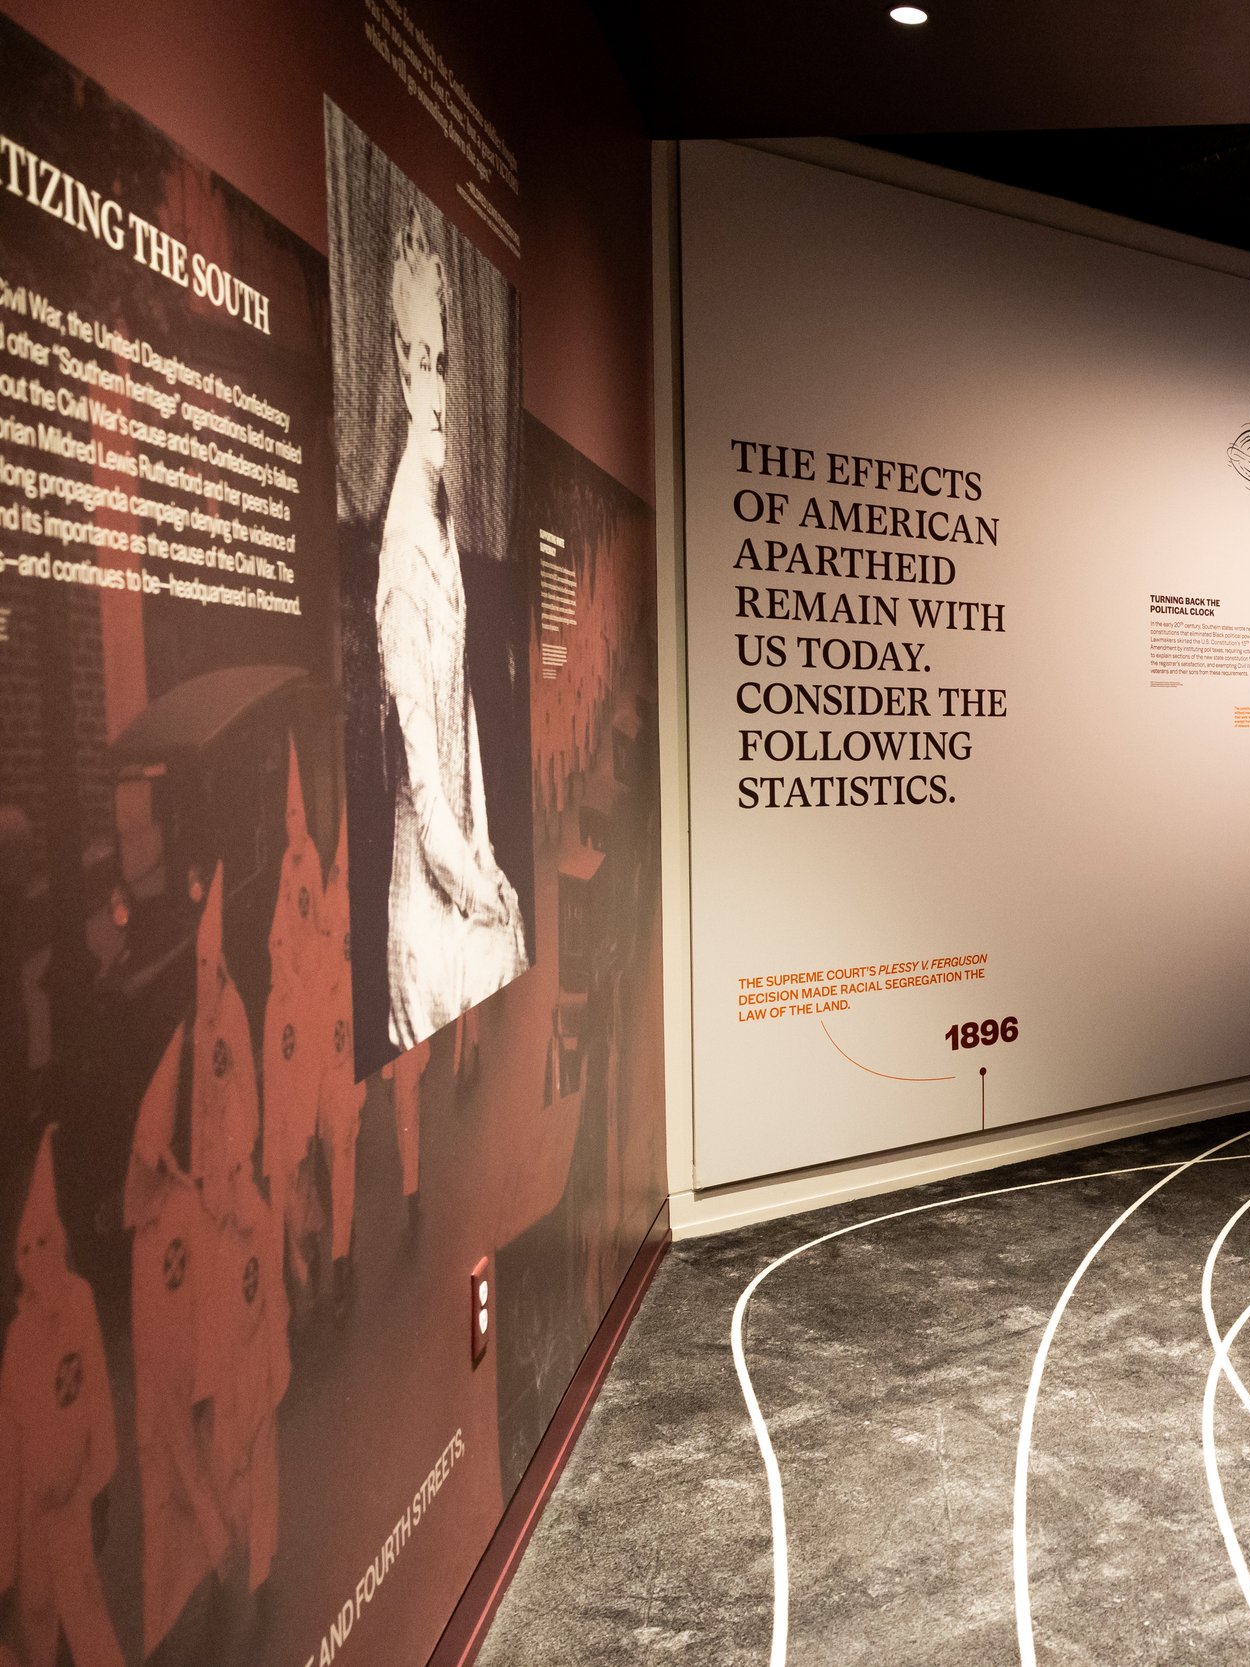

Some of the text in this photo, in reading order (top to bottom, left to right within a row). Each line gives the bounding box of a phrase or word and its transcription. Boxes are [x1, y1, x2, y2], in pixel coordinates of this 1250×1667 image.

[0, 134, 271, 335] TIZING THE SOUTH
[29, 290, 290, 433] War, the United Daughters of the Confederacy
[7, 331, 50, 367] other
[181, 401, 247, 443] organizations
[247, 424, 264, 450] lied
[275, 439, 302, 464] misled
[29, 379, 56, 411] the
[57, 388, 88, 421] Civil
[129, 418, 166, 448] cause
[167, 432, 189, 456] and
[190, 436, 208, 462] the
[731, 438, 982, 501] THE EFFECTS
[733, 489, 1000, 546] OF AMERICAN
[733, 537, 956, 586] APARTHEID
[735, 585, 1006, 632] REMAIN WITH
[1150, 594, 1221, 607] TURNING BACK THE
[1150, 605, 1215, 616] POLITICAL CLOCK
[734, 633, 931, 673] US TODAY.
[736, 681, 1007, 717] CONSIDER THE
[738, 729, 972, 762] FOLLOWING
[737, 774, 956, 809] STATISTICS.
[738, 953, 988, 989] THE SUPREME COURT'S PLESSY V. FERGUSON
[738, 968, 985, 1006] DECISION MADE RACIAL SEGREGATION THE
[738, 1000, 851, 1022] LAW OF THE LAND.
[945, 1016, 1019, 1050] 1896
[319, 1427, 465, 1667] AND FOURTH STREETS,
